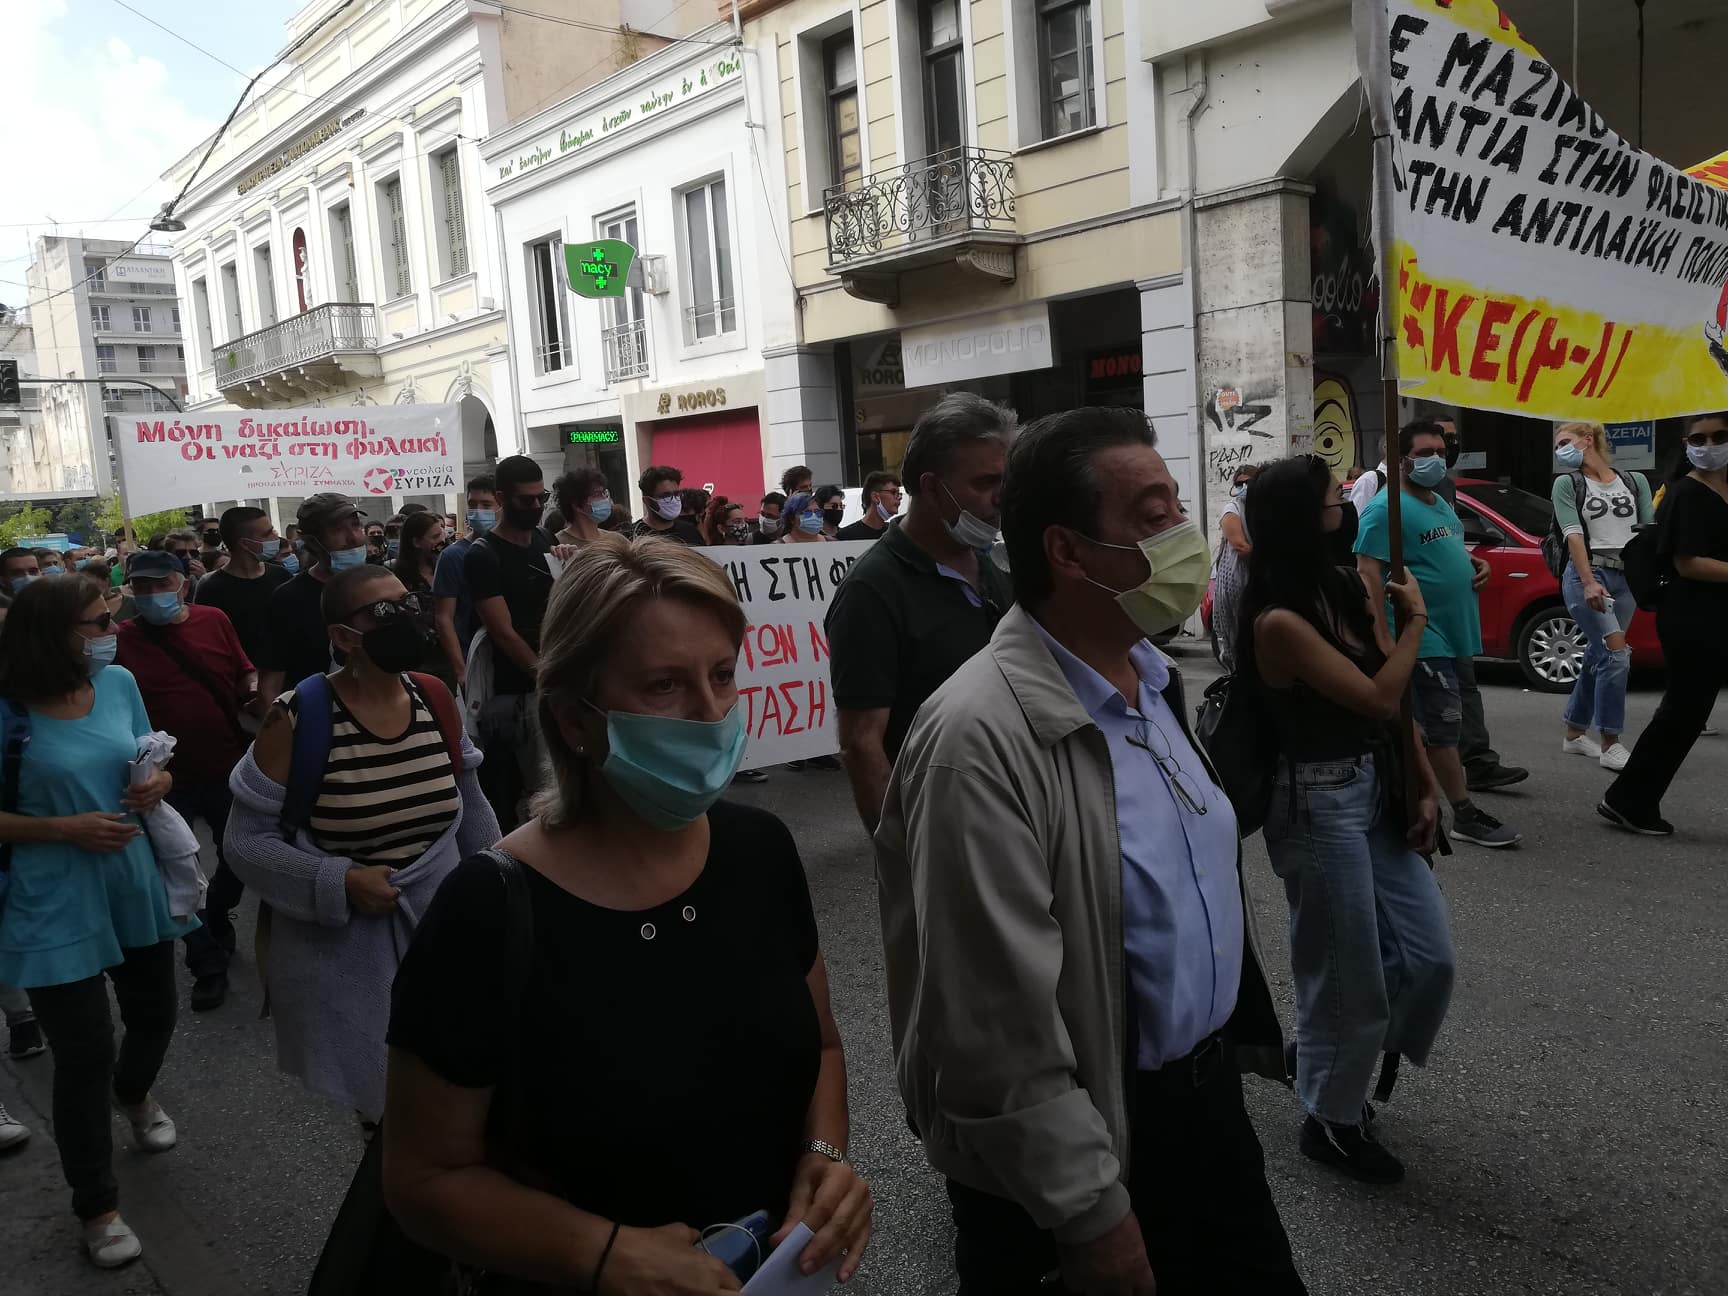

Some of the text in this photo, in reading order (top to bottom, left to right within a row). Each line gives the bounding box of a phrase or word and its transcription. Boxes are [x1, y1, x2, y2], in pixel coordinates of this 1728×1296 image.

[904, 323, 1045, 369] MONOPOLIO
[677, 387, 727, 412] ROROS
[136, 420, 222, 442] Μόνη
[573, 432, 616, 442] PHARMACY
[181, 432, 447, 461] Οι ναζί στη φυλακή
[270, 460, 333, 480] ΣΥΡΙΖΑ
[406, 463, 453, 475] νεολαία
[395, 475, 455, 490] ΣΥΡΙΖΑ
[1586, 495, 1634, 520] 98
[760, 557, 825, 601] ΣΤΗ
[738, 680, 826, 739] ΤΑΣΗ
